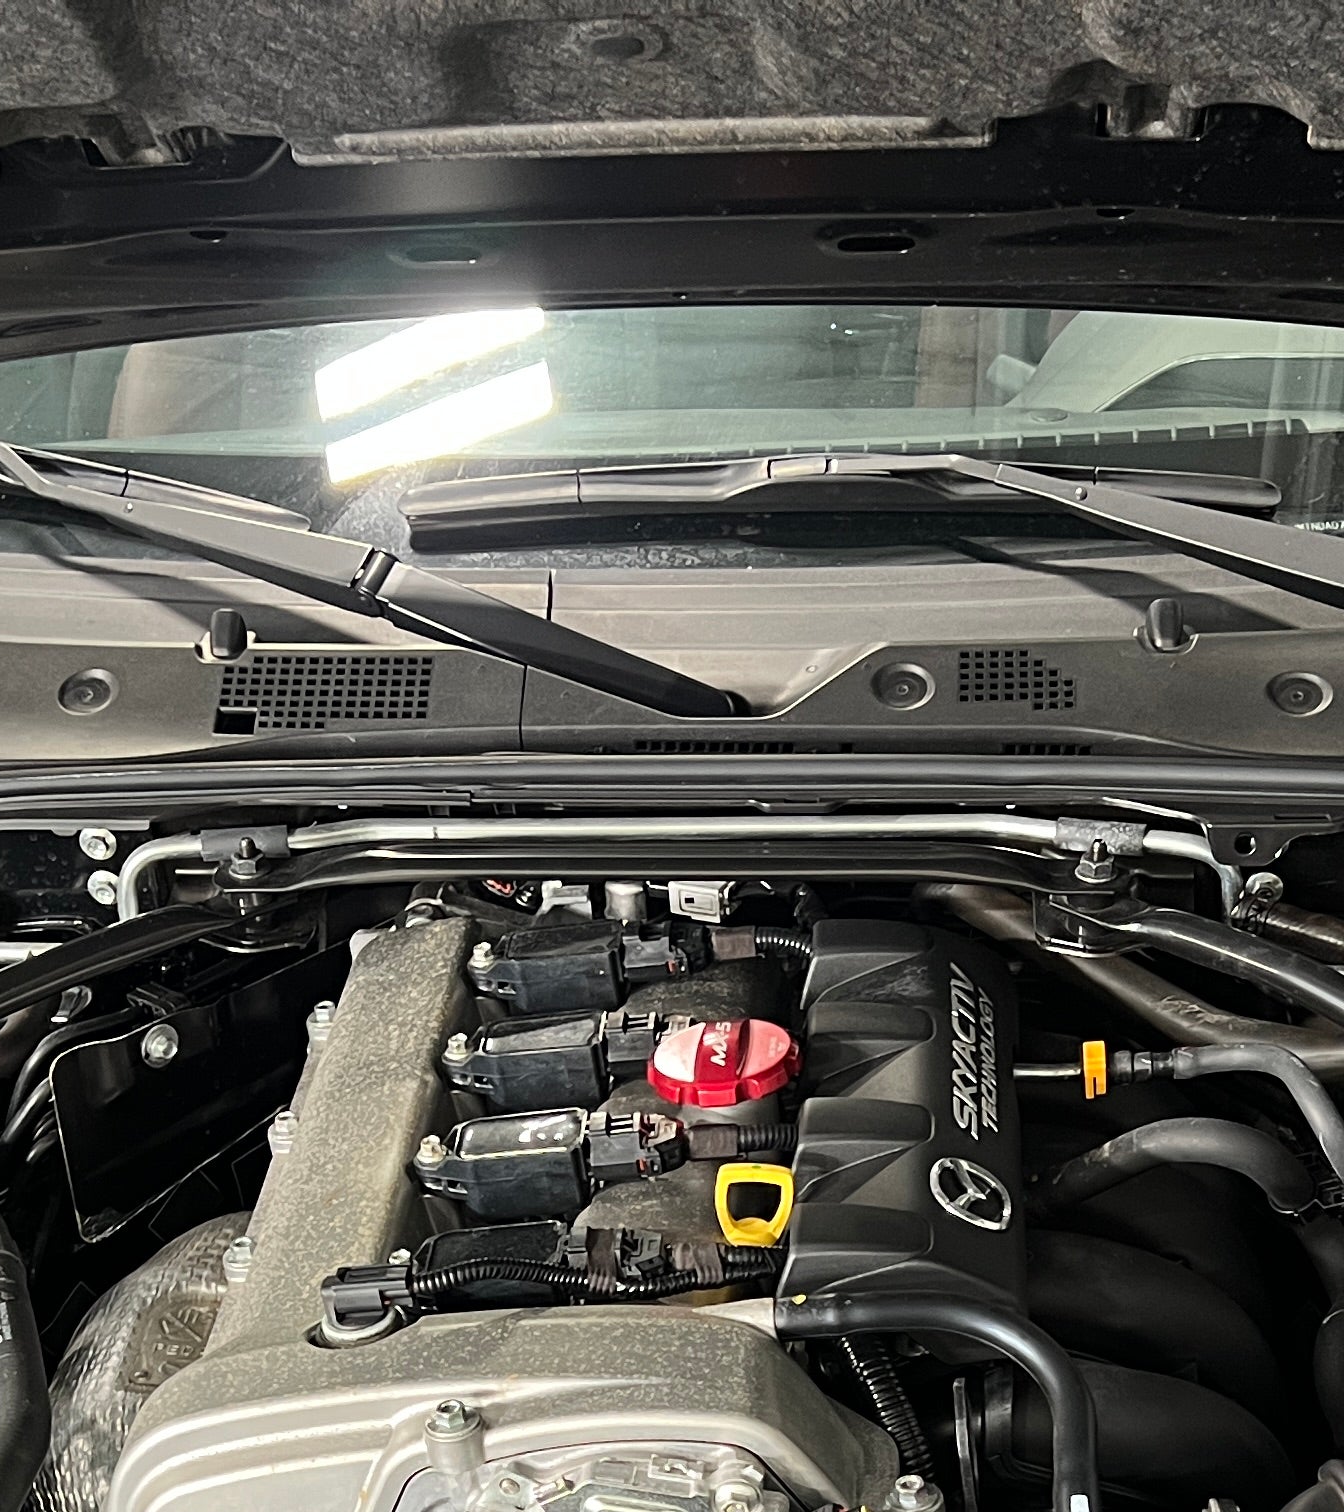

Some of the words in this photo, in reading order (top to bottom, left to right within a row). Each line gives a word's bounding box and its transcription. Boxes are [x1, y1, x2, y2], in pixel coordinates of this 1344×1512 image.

[704, 1022, 732, 1066] MX-5
[950, 962, 978, 1140] SKYACTIV
[978, 987, 998, 1132] TECHNOLOGY
